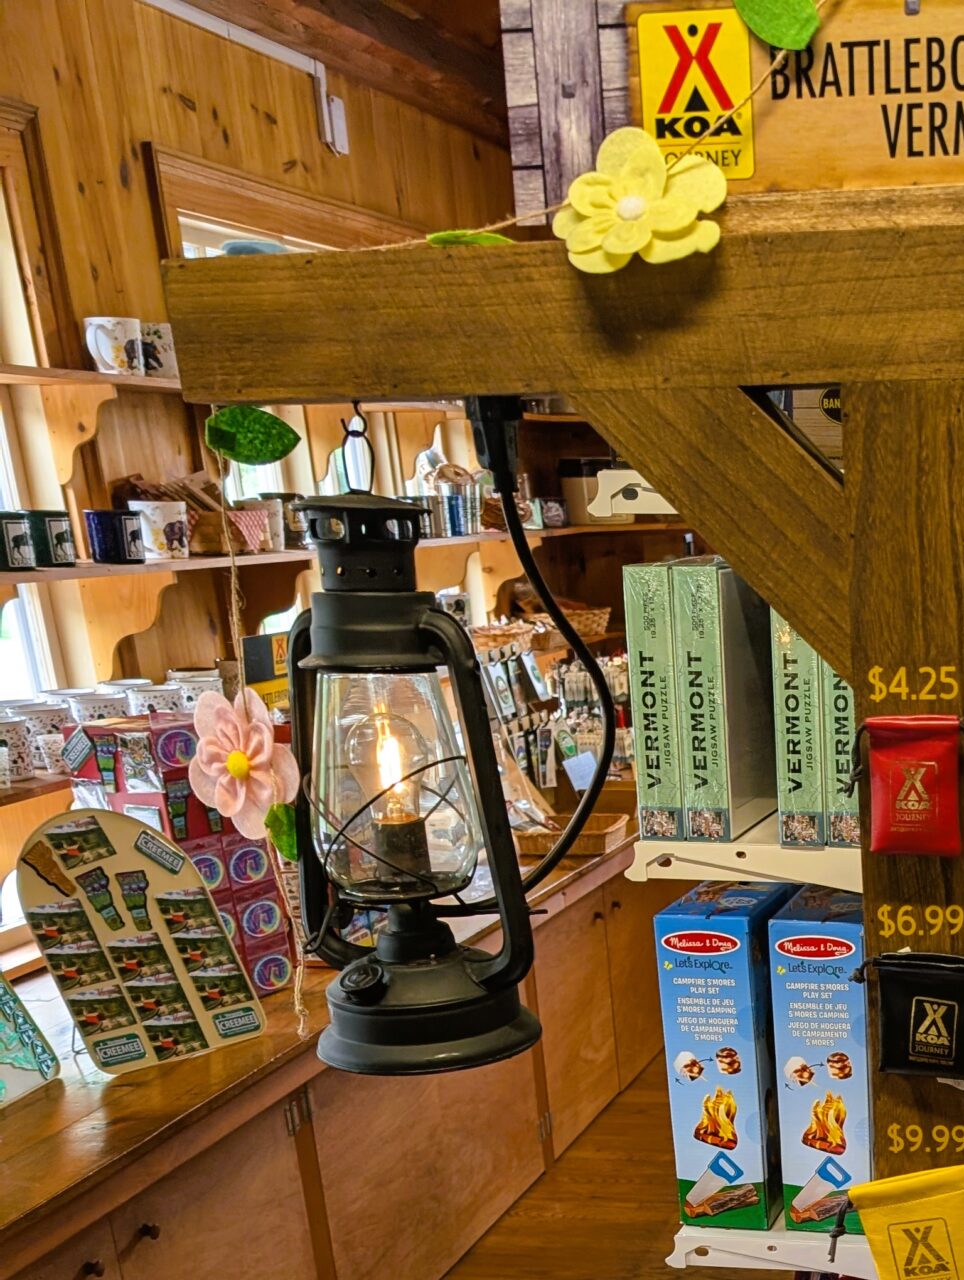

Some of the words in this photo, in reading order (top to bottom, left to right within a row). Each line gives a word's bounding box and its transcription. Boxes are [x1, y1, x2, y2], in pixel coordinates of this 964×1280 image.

[655, 116, 742, 139] KOA
[867, 665, 959, 702] $4.25
[659, 676, 670, 719] PUZZLE
[707, 676, 717, 720] PUZZLE
[803, 678, 812, 722] PUZZLE
[639, 651, 662, 790] VERMONT
[687, 651, 708, 790] VERMONT
[783, 652, 803, 793] VERMONT
[832, 673, 853, 795] VERMON
[662, 727, 672, 767] JIGSAW
[709, 727, 718, 768] JIGSAW
[805, 730, 813, 771] JIGSAW
[896, 800, 931, 810] KOA
[141, 838, 179, 867] CREEMEE
[877, 904, 964, 938] $6.99
[670, 937, 703, 948] Melissa
[784, 942, 818, 953] Melissa
[675, 958, 693, 968] Let's
[695, 960, 730, 974] Explore
[789, 962, 807, 972] Let's
[808, 964, 844, 978] Explore
[678, 997, 710, 1005] ENSEMBLE
[220, 1017, 255, 1031] CREEMEE
[709, 1017, 738, 1025] HOGUERA
[802, 1030, 847, 1038] CAMPAMENTO
[915, 1033, 950, 1046] KOA
[101, 1043, 140, 1058] CREEMEE
[914, 1044, 950, 1056] JOURNEY
[903, 1265, 951, 1277] KOA
